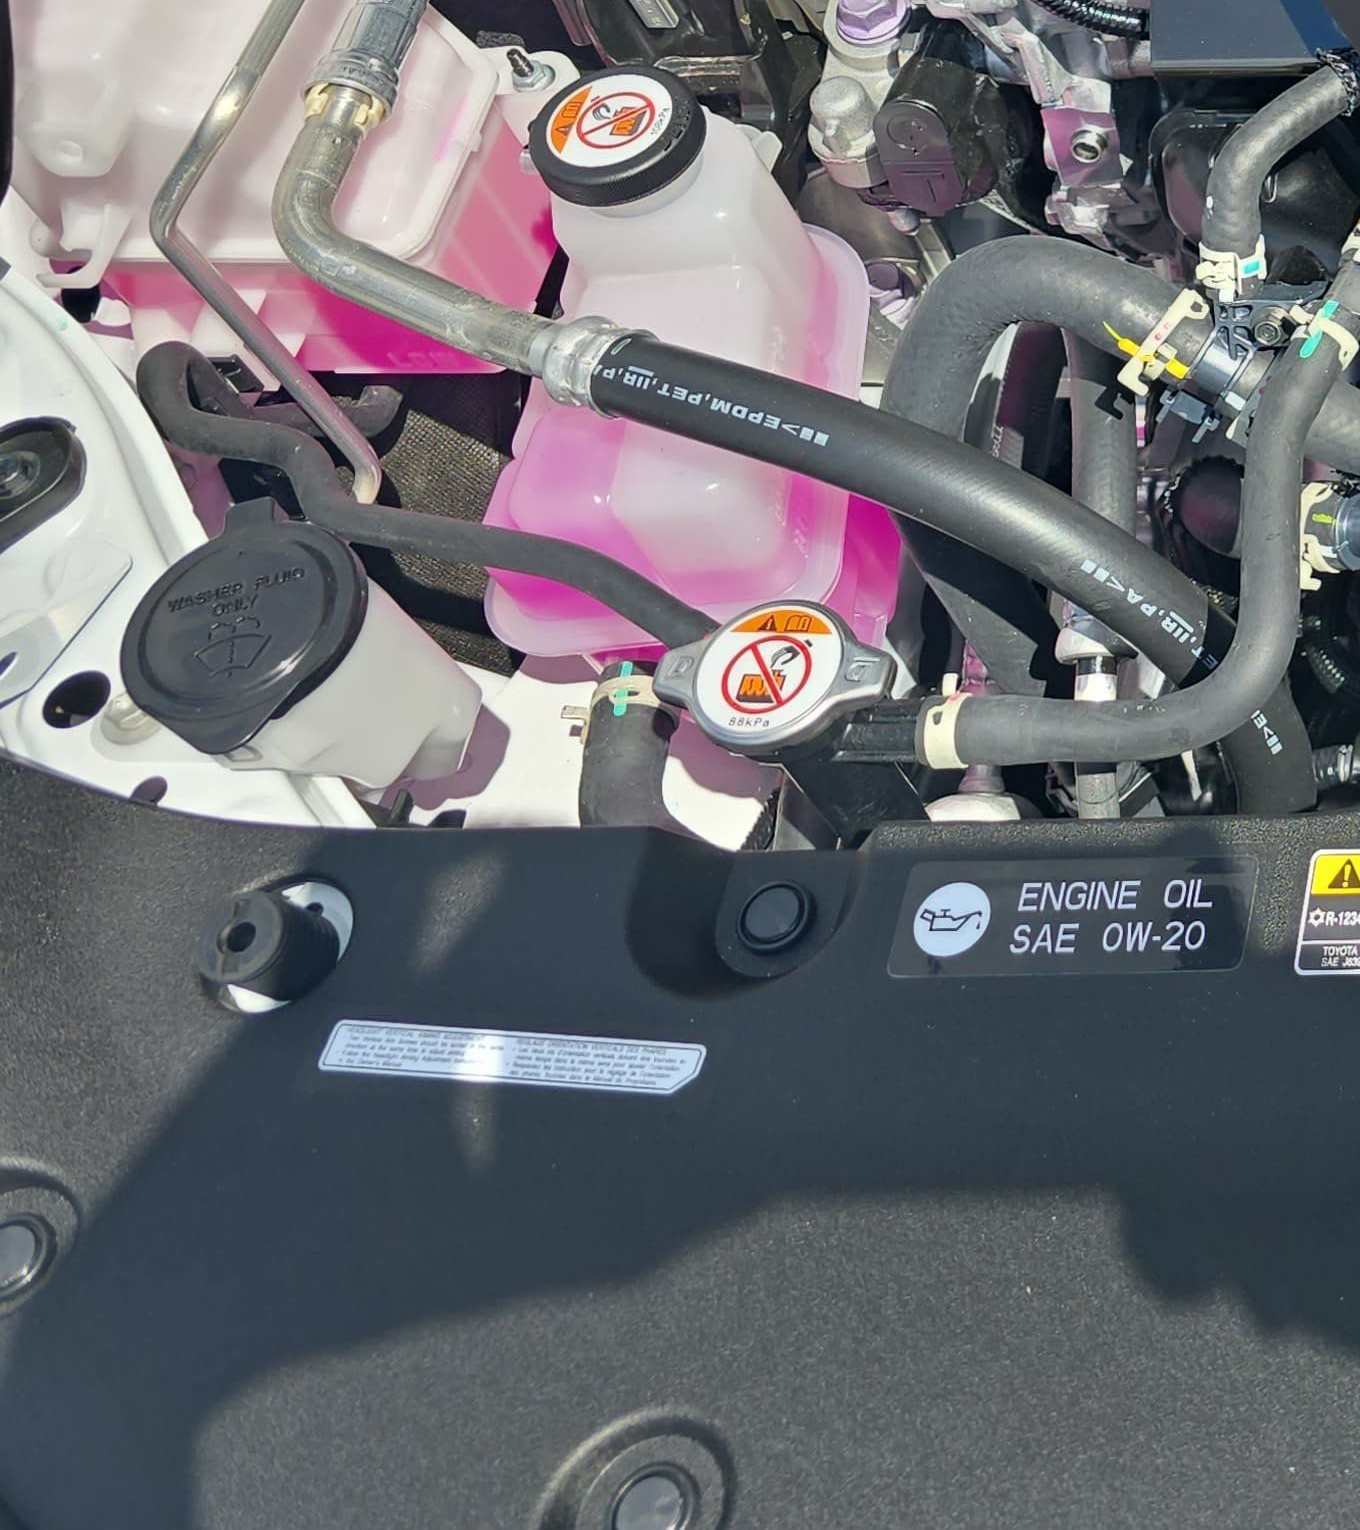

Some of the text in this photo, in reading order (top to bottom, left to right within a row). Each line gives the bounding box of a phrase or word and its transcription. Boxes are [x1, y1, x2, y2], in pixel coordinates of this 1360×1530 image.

[167, 566, 306, 613] WASHER FLUID
[211, 592, 259, 616] ONLY
[728, 716, 770, 728] 88kPa
[1017, 878, 1214, 912] ENGINE OIL
[1008, 920, 1207, 954] SAE 0W-20
[1320, 956, 1340, 967] SAE
[1322, 945, 1358, 956] TOYOTA
